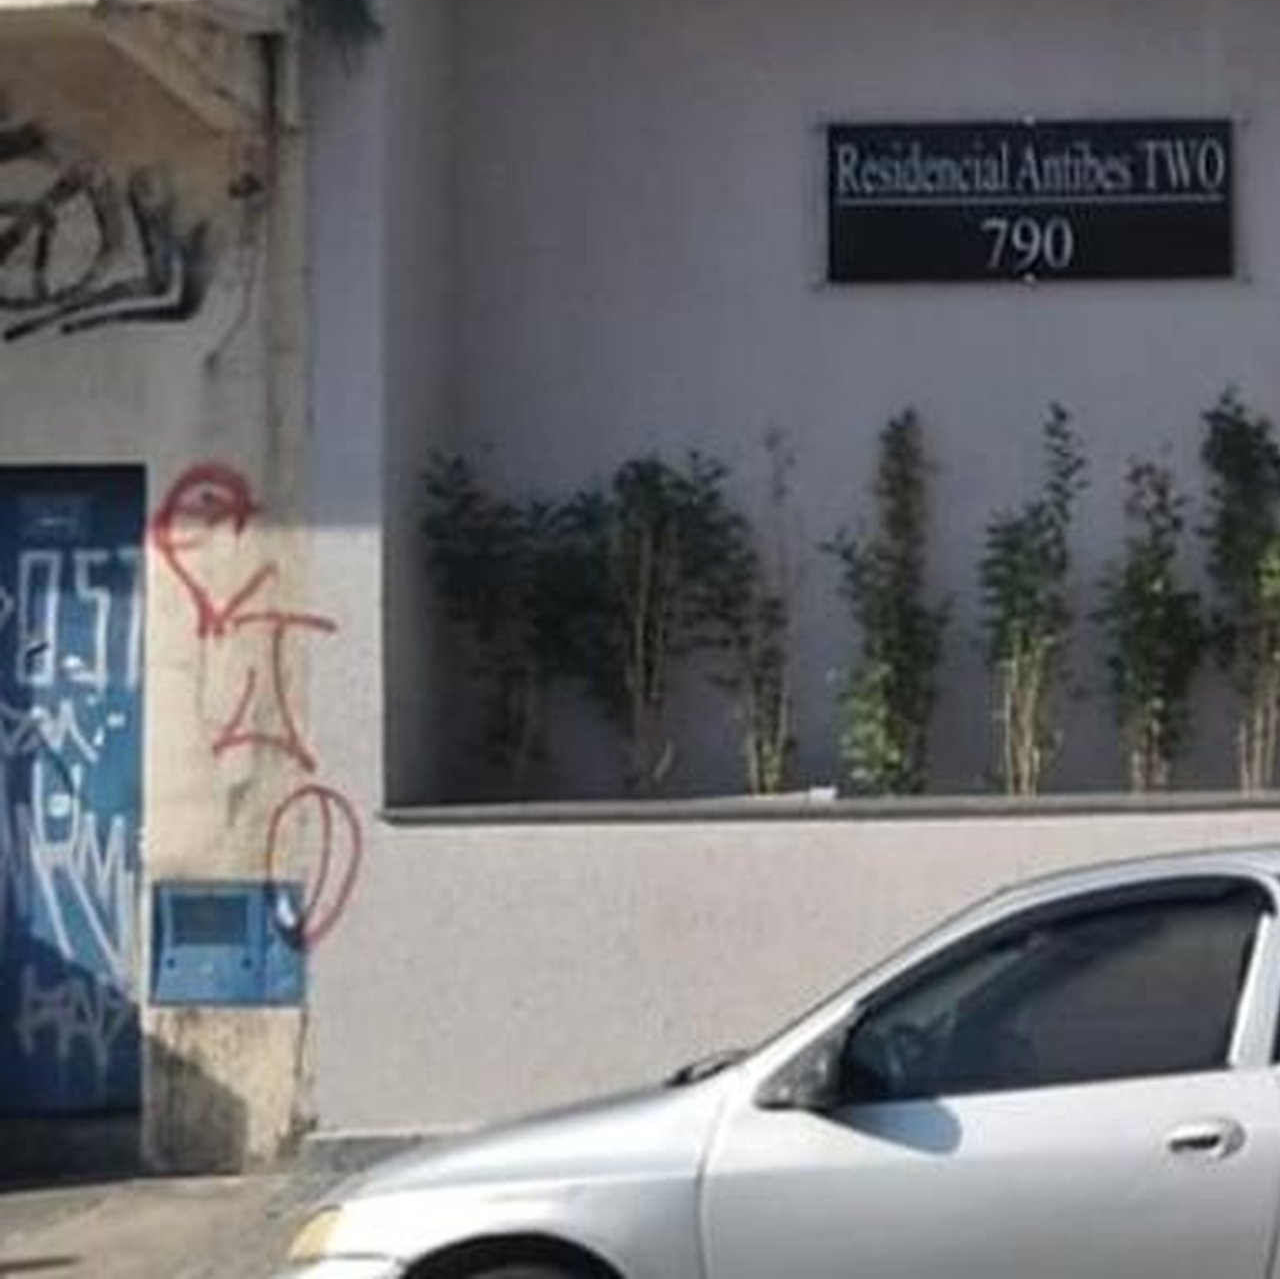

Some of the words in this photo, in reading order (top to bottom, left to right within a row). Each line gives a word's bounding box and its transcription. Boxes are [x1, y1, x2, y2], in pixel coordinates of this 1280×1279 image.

[836, 140, 1009, 195] Residencial
[1016, 137, 1131, 193] Antibes
[1140, 136, 1225, 189] TWO
[981, 218, 1074, 270] 790
